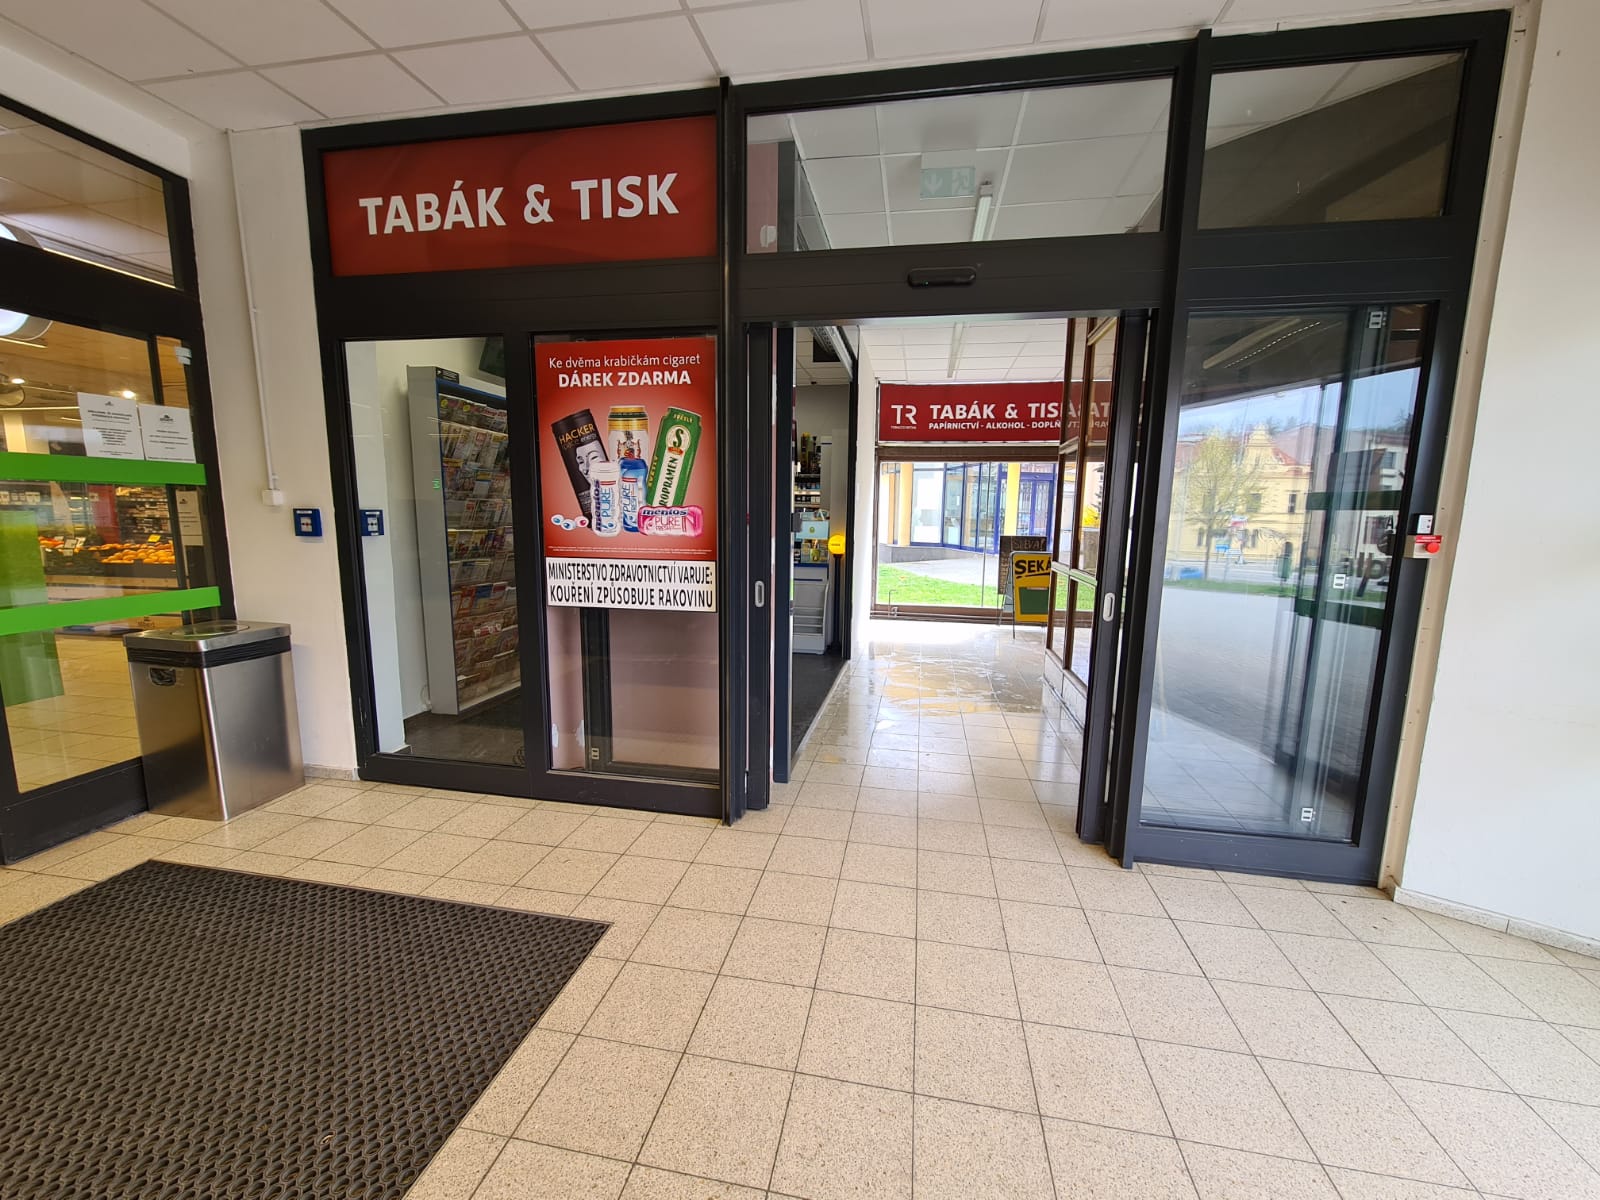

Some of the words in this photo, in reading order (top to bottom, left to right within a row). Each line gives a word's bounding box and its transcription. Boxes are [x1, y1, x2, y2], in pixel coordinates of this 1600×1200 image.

[359, 180, 506, 235] TABÁK
[523, 184, 553, 223] &
[571, 172, 680, 221] TISK
[549, 357, 563, 369] Ke
[566, 356, 600, 368] dvěma
[604, 354, 660, 368] krabičkám
[663, 353, 701, 368] cigaret
[558, 370, 613, 388] DÁREK
[617, 370, 691, 386] ZDARMA
[891, 404, 917, 425] TR
[929, 400, 996, 419] TABÁK
[1005, 402, 1018, 419] &
[1028, 402, 1062, 419] TIS
[559, 423, 594, 445] HACKER
[928, 420, 979, 430] PAPÍRNICTVÍ
[986, 421, 1025, 429] ALKOHOL
[1031, 419, 1061, 429] DOPLŇ
[658, 456, 679, 507] ROPRAMEN
[655, 516, 681, 527] PURE
[548, 562, 608, 581] MINISTERSTVO
[609, 561, 678, 583] ZDRAVOTNICTVÍ
[677, 565, 713, 585] VARUJE:
[1014, 556, 1052, 575] SEKÁ
[550, 582, 594, 603] KOUŘENÍ
[597, 583, 655, 606] ZPŮSOBUJE
[657, 588, 713, 608] RAKOVINU
